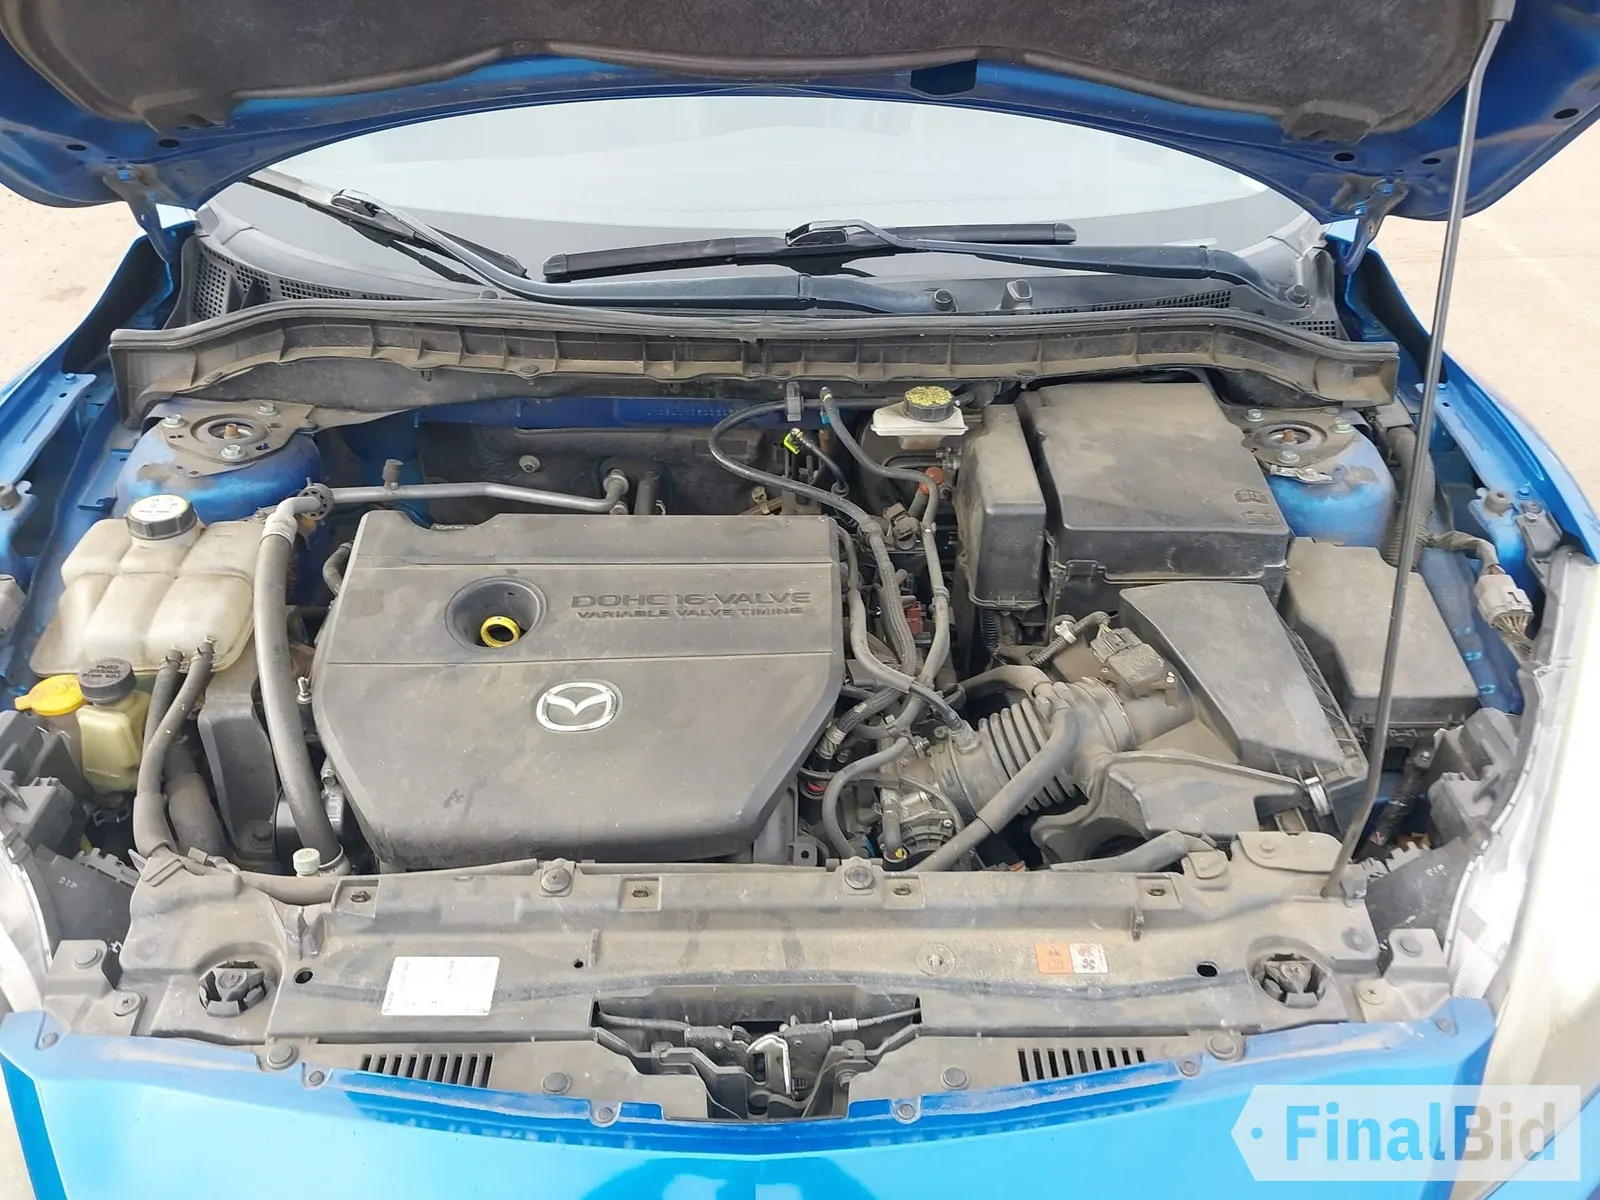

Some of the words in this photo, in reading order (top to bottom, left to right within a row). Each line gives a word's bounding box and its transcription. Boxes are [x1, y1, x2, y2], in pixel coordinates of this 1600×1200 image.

[571, 594, 669, 608] DOHC
[675, 591, 812, 606] 16-VALVE
[577, 609, 671, 619] VARIABLE
[676, 608, 733, 617] VALVE
[738, 606, 804, 616] TIMING
